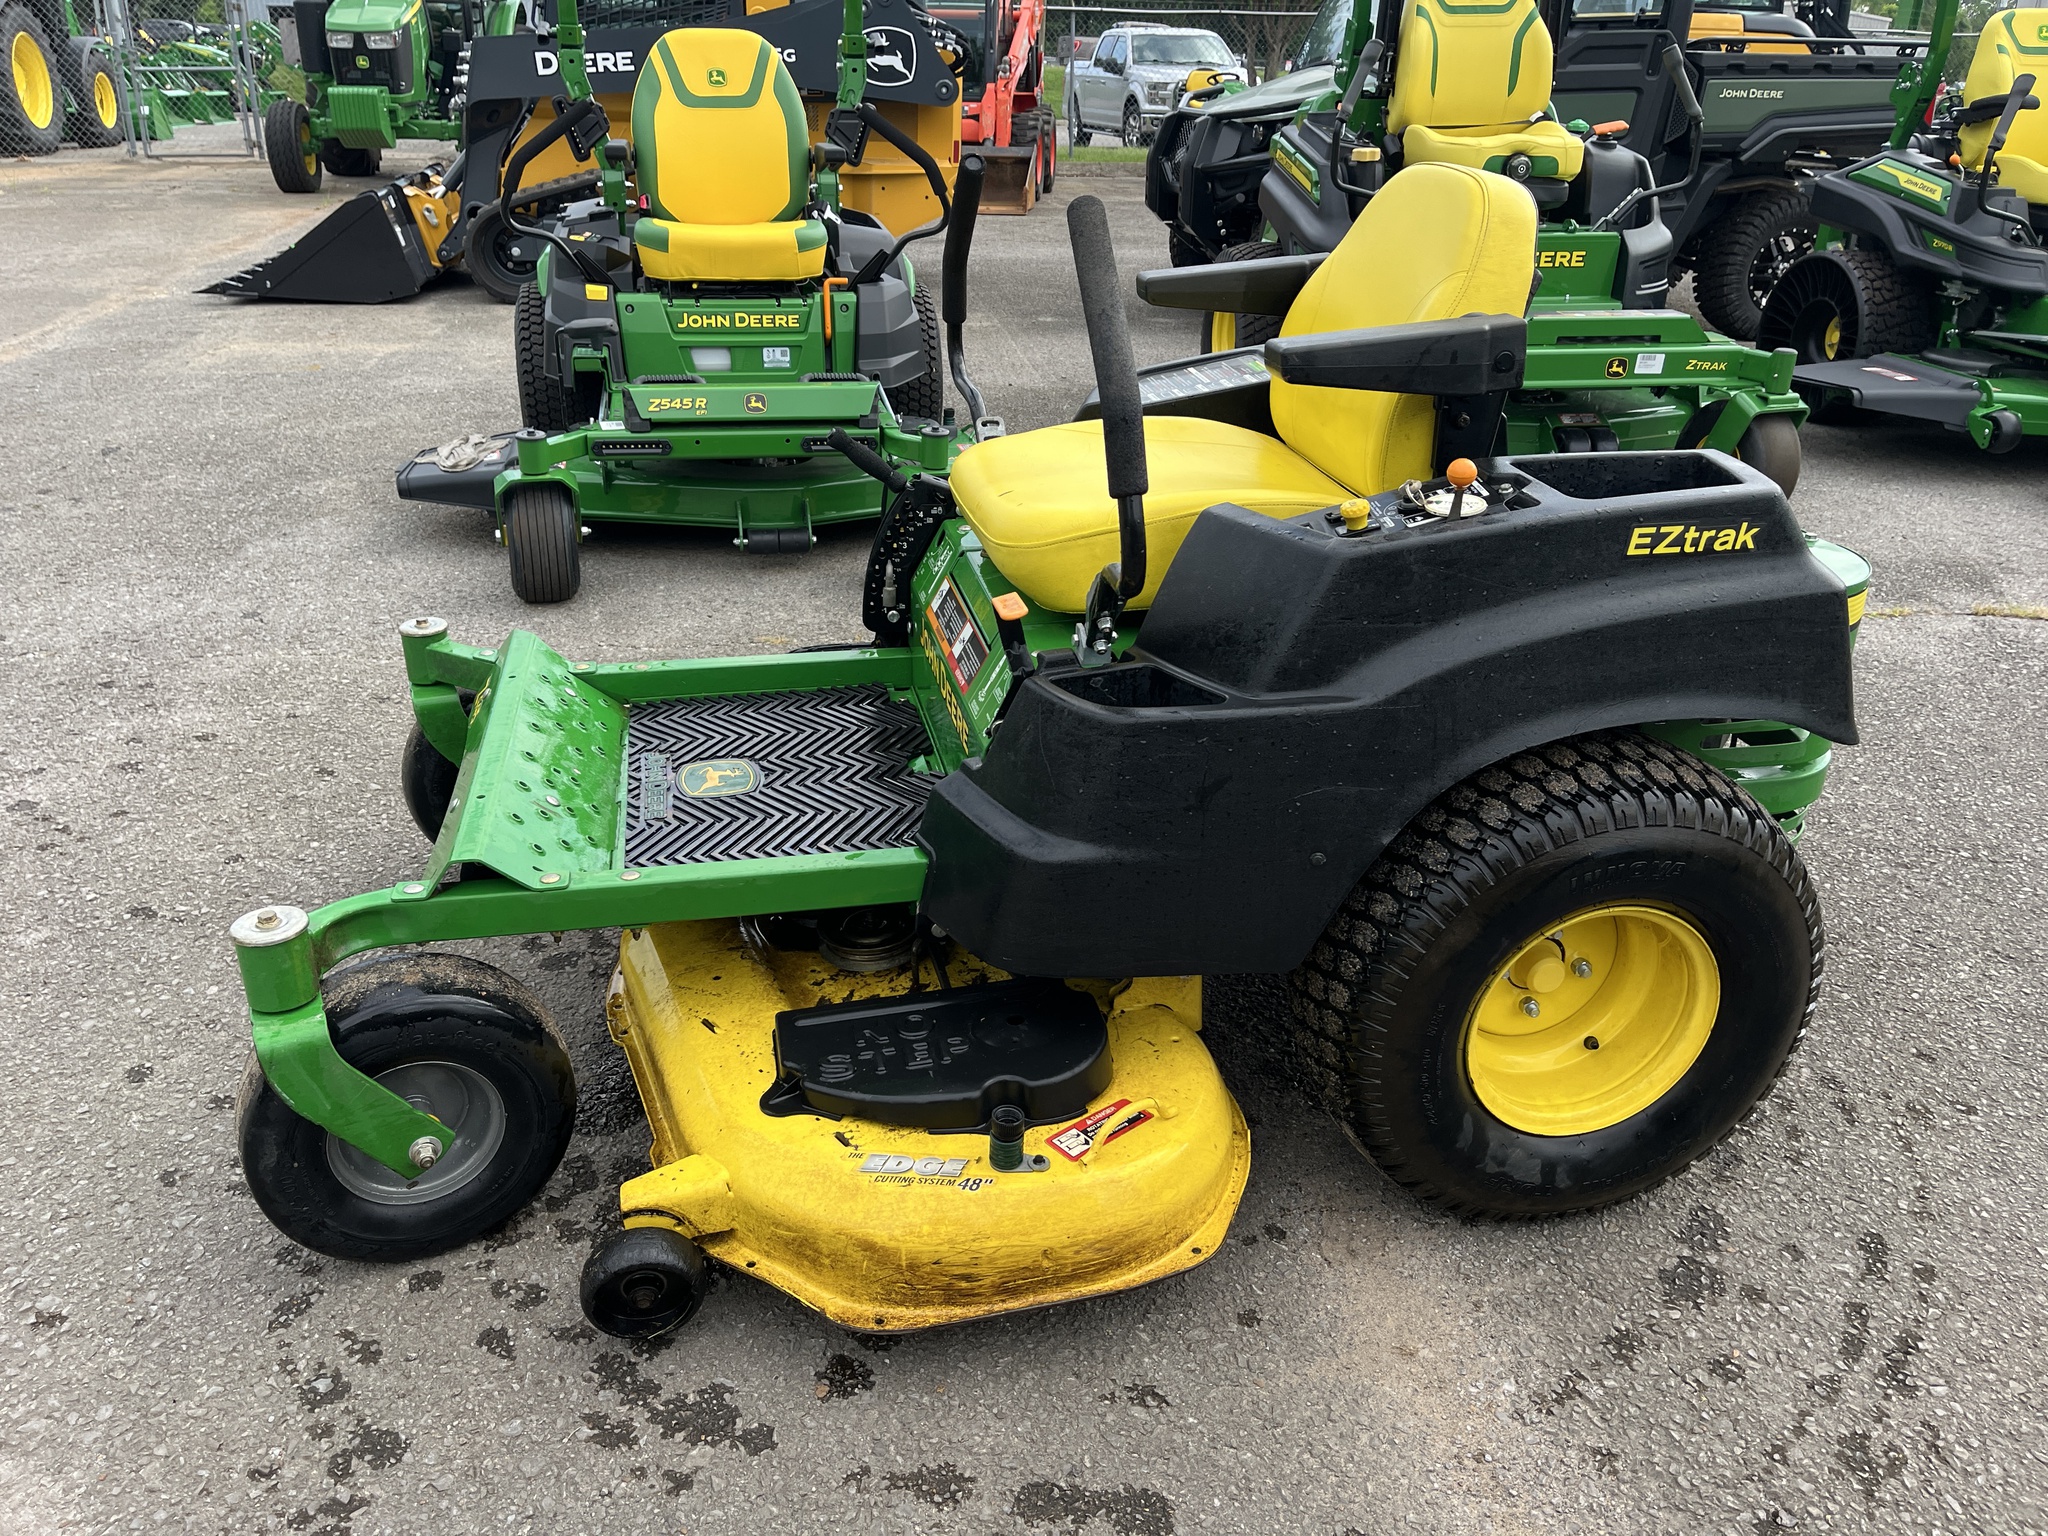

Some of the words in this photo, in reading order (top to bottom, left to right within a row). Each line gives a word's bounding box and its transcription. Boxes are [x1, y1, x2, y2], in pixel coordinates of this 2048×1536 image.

[534, 50, 636, 76] DERE
[1719, 88, 1748, 98] JOHN
[1749, 88, 1785, 99] DEERE
[1904, 177, 1919, 188] JOHN
[1919, 183, 1938, 195] DEERE
[677, 312, 730, 328] JOHN
[734, 312, 800, 328] DEERE
[1685, 359, 1728, 371] ZTRAK
[1626, 522, 1761, 556] EZtrak
[920, 617, 940, 685] JOHN
[940, 659, 969, 756] DEERE
[645, 751, 671, 781] JOHN
[645, 780, 670, 820] DEERE
[855, 1014, 937, 1048] NO
[819, 1036, 970, 1082] STEP
[858, 1153, 970, 1177] EDGE
[874, 1175, 916, 1185] CUTTING
[916, 1178, 956, 1187] SYSTEM
[957, 1177, 994, 1191] 48"
